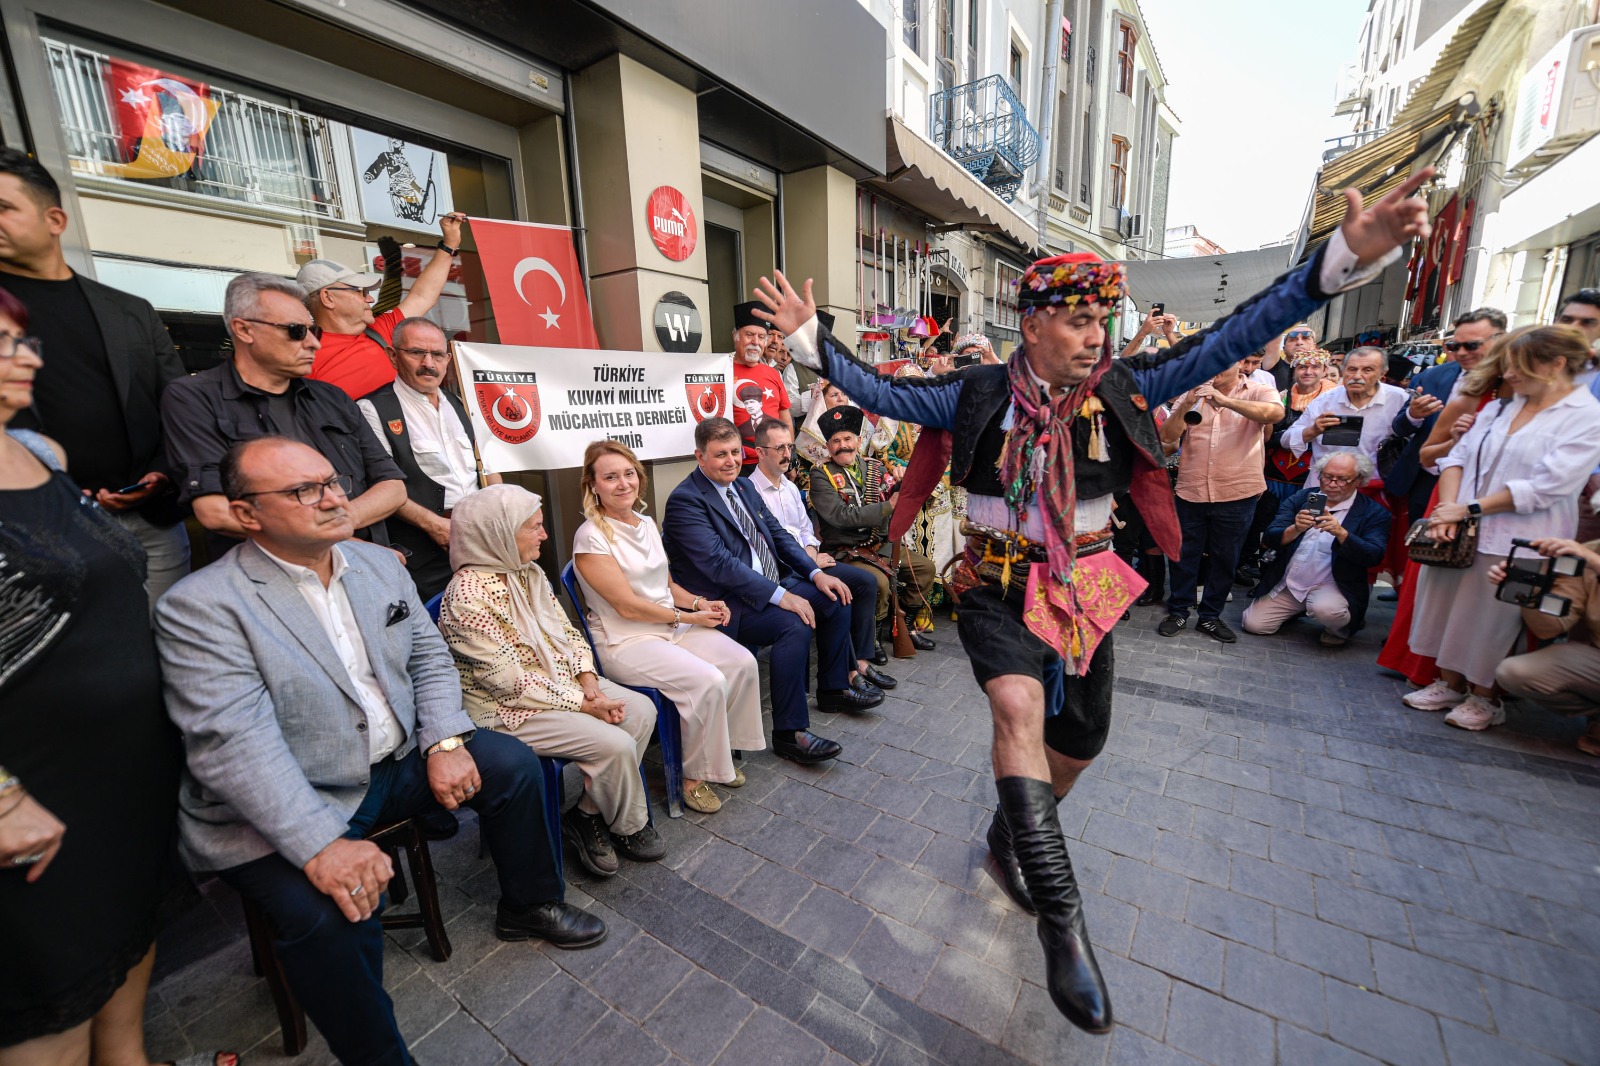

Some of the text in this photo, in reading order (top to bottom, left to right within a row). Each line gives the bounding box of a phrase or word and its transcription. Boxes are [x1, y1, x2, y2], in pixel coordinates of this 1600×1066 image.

[653, 216, 684, 237] PUMA
[935, 275, 942, 287] 6
[664, 312, 691, 342] W
[476, 372, 534, 382] TÜRKİYE
[593, 364, 645, 382] TÜRKİYE
[686, 374, 724, 383] TÜRKİYE
[567, 386, 665, 406] KUVAYİ MİLLİYE
[548, 410, 633, 431] MÜCAHİTLER
[636, 406, 687, 426] DERNEĞİ
